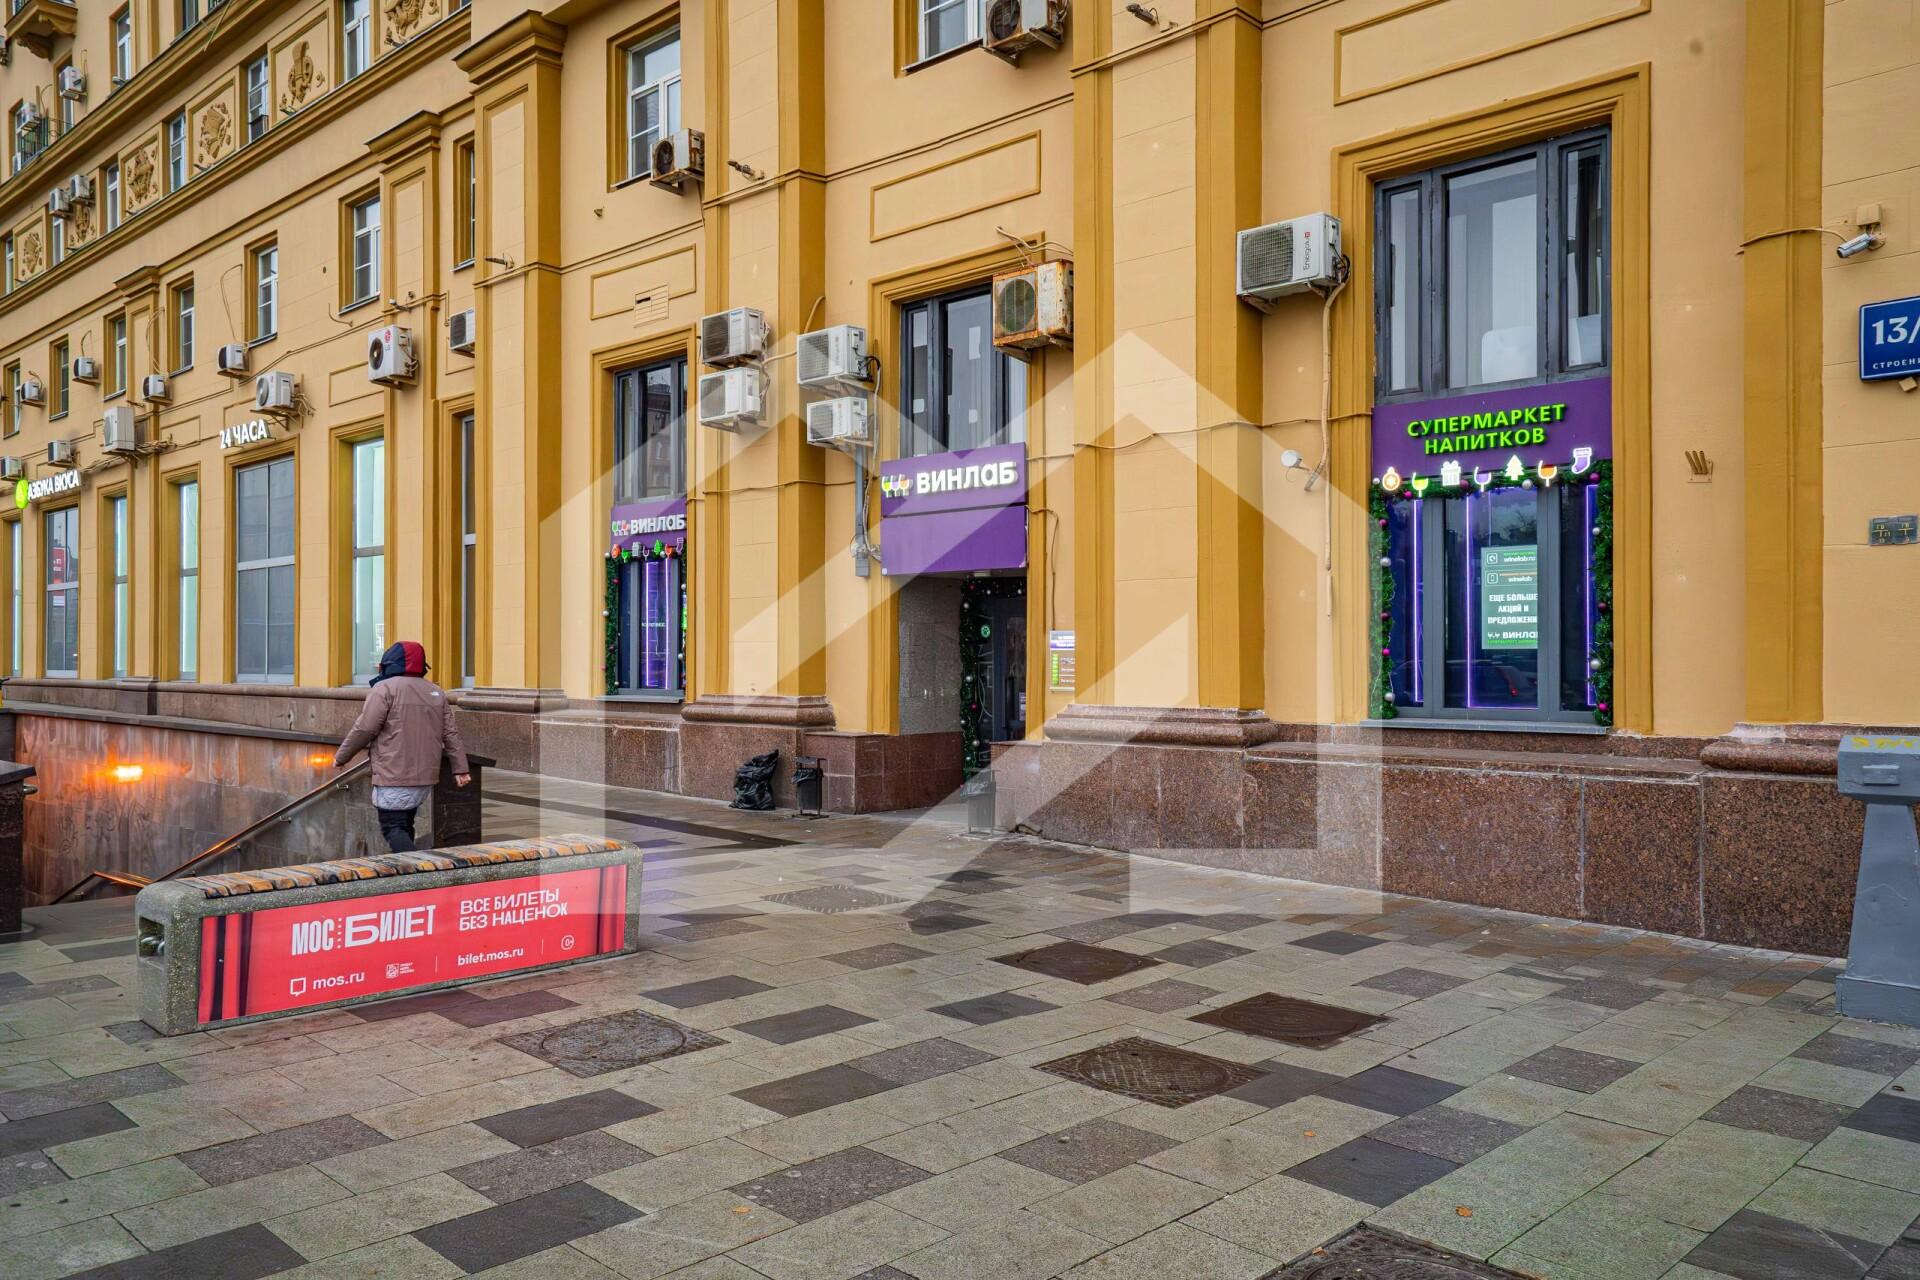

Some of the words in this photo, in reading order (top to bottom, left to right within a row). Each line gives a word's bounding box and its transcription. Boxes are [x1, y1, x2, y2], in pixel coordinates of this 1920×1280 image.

[220, 428, 231, 448] 24
[233, 419, 268, 445] ЧАСА
[1407, 403, 1566, 437] СУПЕРМАРКЕТ
[1425, 427, 1546, 454] НАПИТКОВ
[28, 477, 54, 500] АЗБУКА
[55, 470, 80, 492] ВКУСА
[1498, 604, 1522, 613] АКЦИЙ
[1524, 604, 1529, 612] И
[460, 898, 490, 915] ВСЕ
[494, 888, 559, 910] БИЛЕТЫ
[291, 918, 335, 956] МОС
[344, 905, 436, 948] БИЛЕТ
[459, 914, 488, 931] БЕЗ
[492, 902, 568, 926] НАЦЕНОК
[457, 947, 524, 966] bilet.mos.ru
[312, 972, 365, 990] mos.ru
